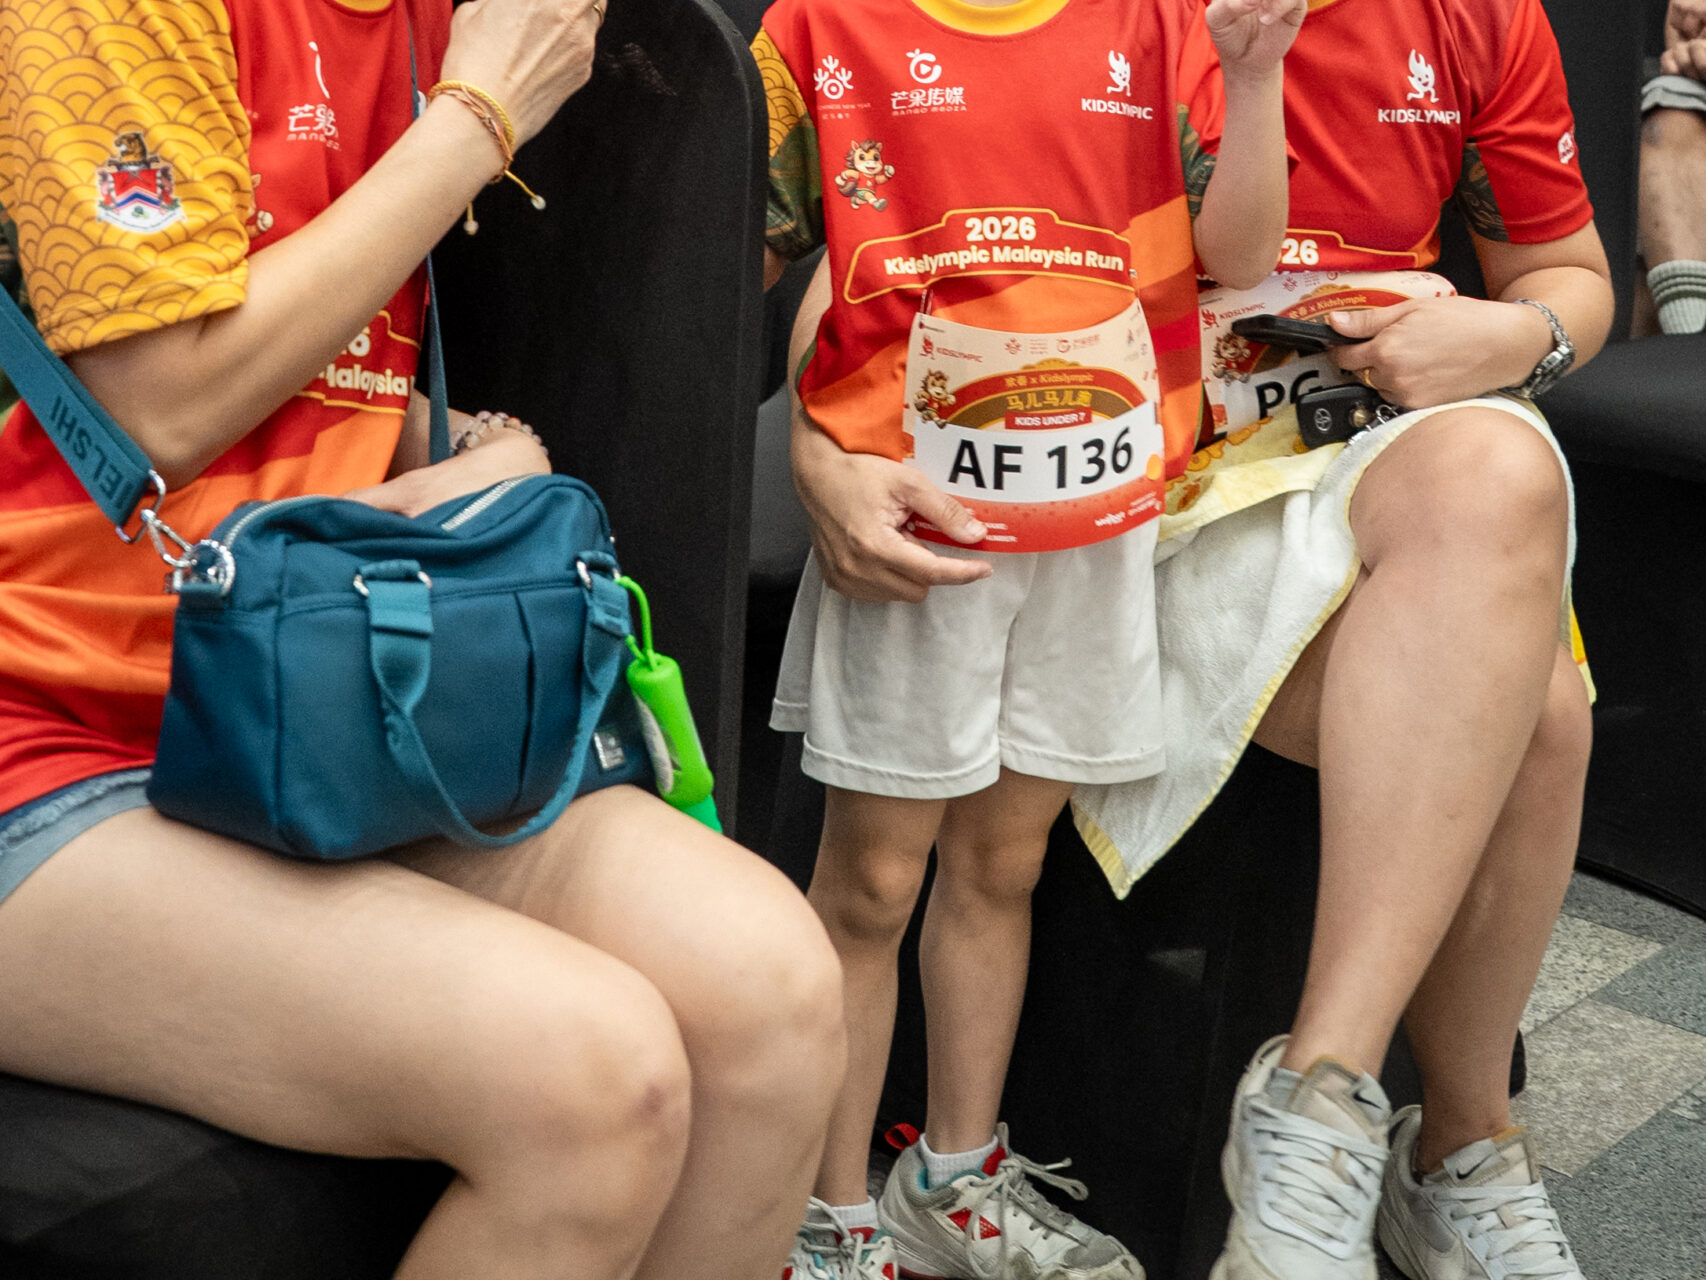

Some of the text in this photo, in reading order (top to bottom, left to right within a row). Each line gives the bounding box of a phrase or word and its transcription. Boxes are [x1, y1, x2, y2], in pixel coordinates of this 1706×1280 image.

[890, 86, 967, 110] 芒果传媒
[1377, 107, 1461, 125] KIDSLYMPI
[964, 215, 1037, 242] 2026
[884, 244, 1125, 276] Kidslympic Malaysia Run
[1280, 238, 1320, 266] 26
[1014, 416, 1041, 426] KIDS
[1041, 412, 1079, 426] UNDER
[948, 426, 1134, 491] AF 136
